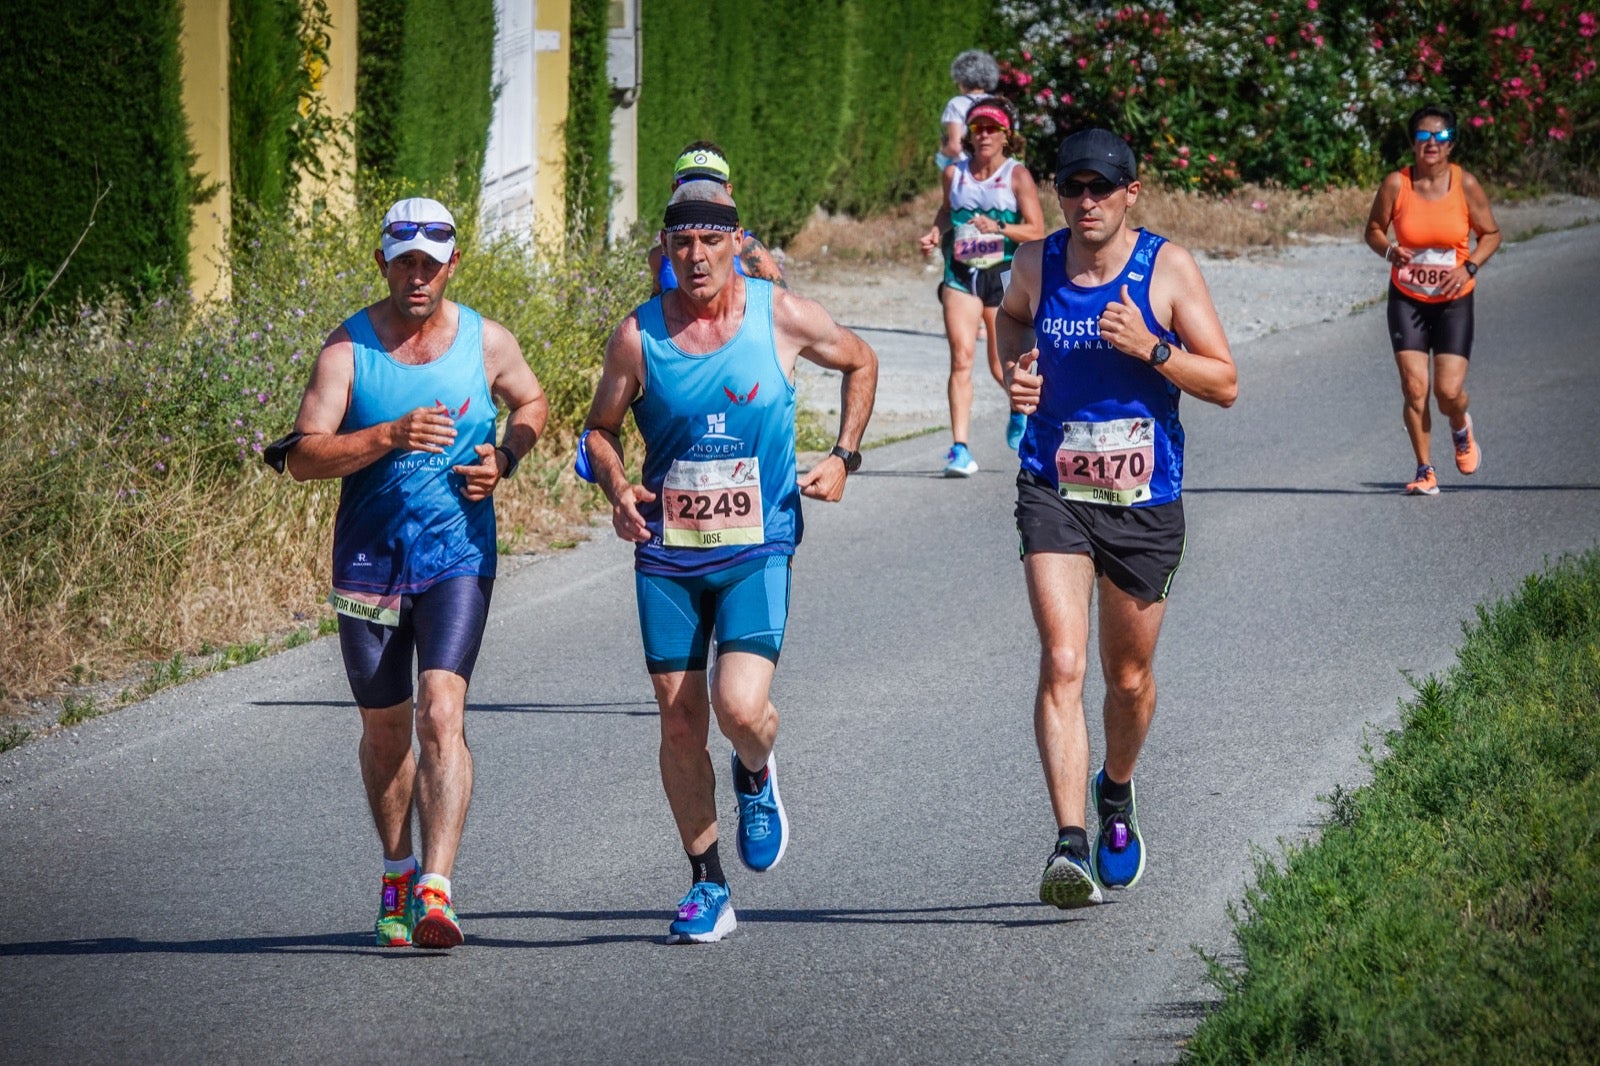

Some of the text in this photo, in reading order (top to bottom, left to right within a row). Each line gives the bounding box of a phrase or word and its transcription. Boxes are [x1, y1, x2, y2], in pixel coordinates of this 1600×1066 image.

[666, 223, 734, 232] MPRESSPORT
[961, 240, 998, 255] 2169
[1042, 315, 1101, 341] agusti
[1054, 340, 1114, 350] GRANAD
[690, 442, 745, 453] NNOVENT
[394, 456, 451, 468] INNOENT
[1073, 452, 1146, 480] 2170
[1093, 488, 1122, 503] DANIEL
[677, 491, 751, 519] 2249
[702, 532, 722, 545] JOSE
[349, 601, 381, 620] MANUEL
